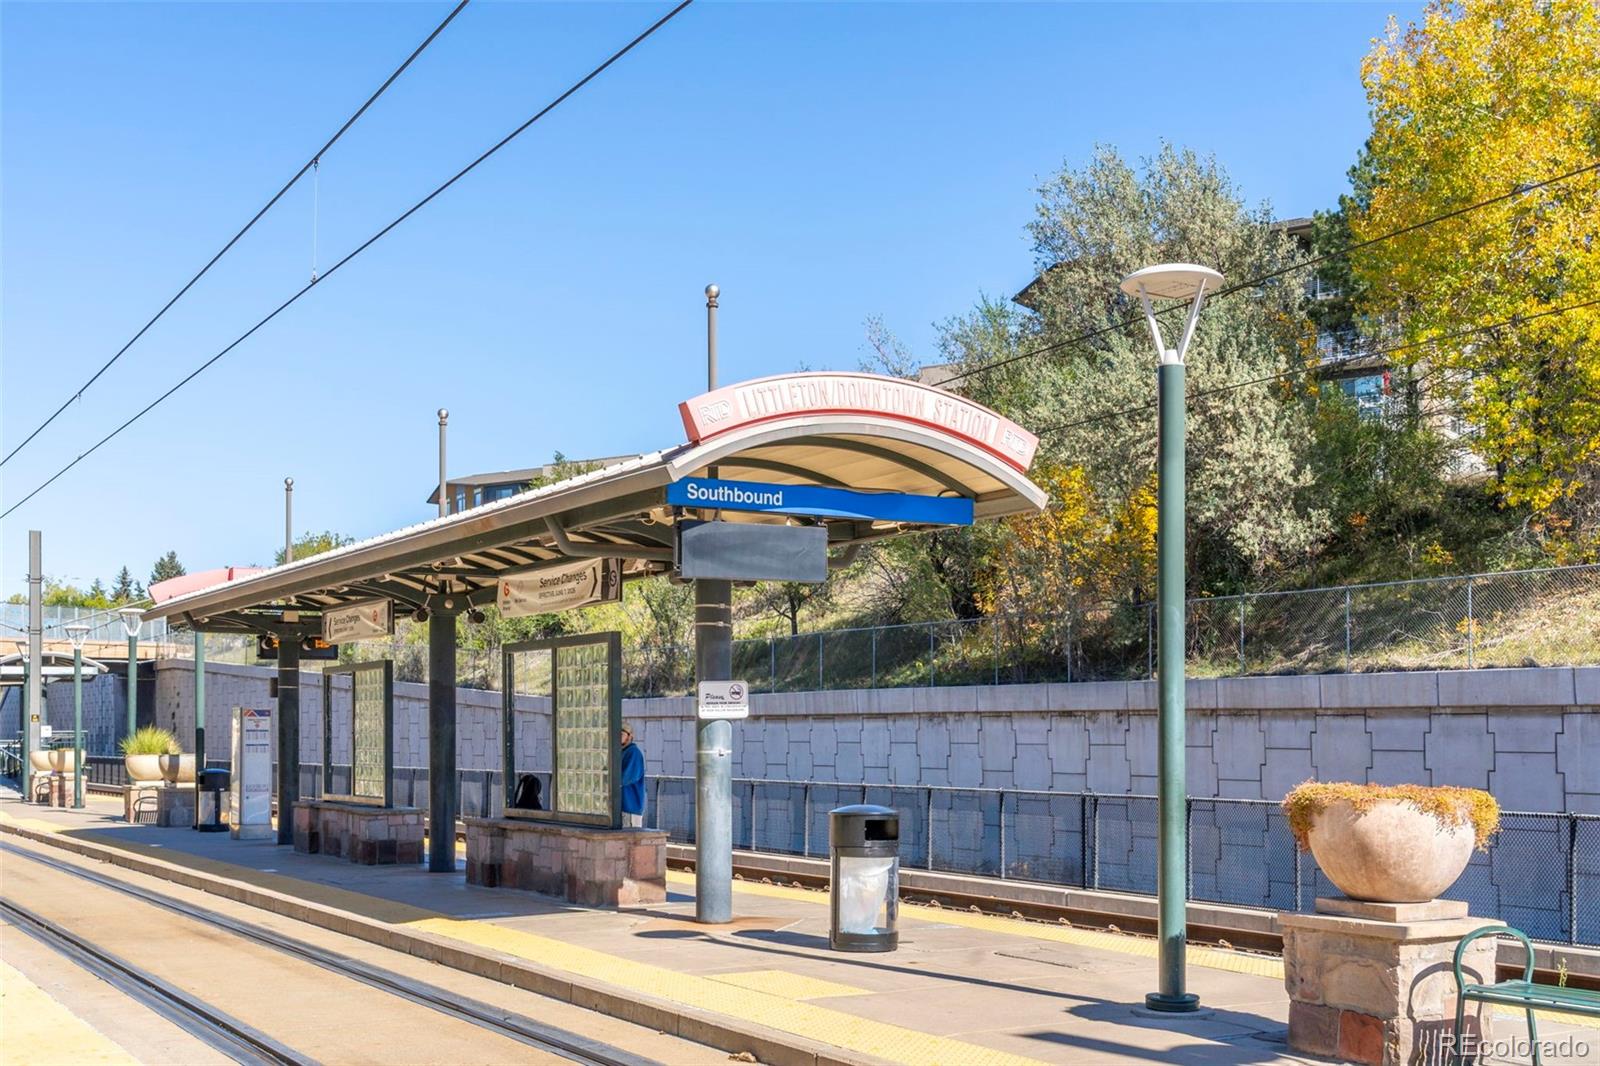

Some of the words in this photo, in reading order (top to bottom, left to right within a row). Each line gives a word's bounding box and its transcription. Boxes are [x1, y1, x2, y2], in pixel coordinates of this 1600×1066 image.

[932, 397, 993, 442] STATION
[686, 482, 783, 507] Southbound
[540, 576, 560, 588] Service
[561, 571, 588, 584] Changes
